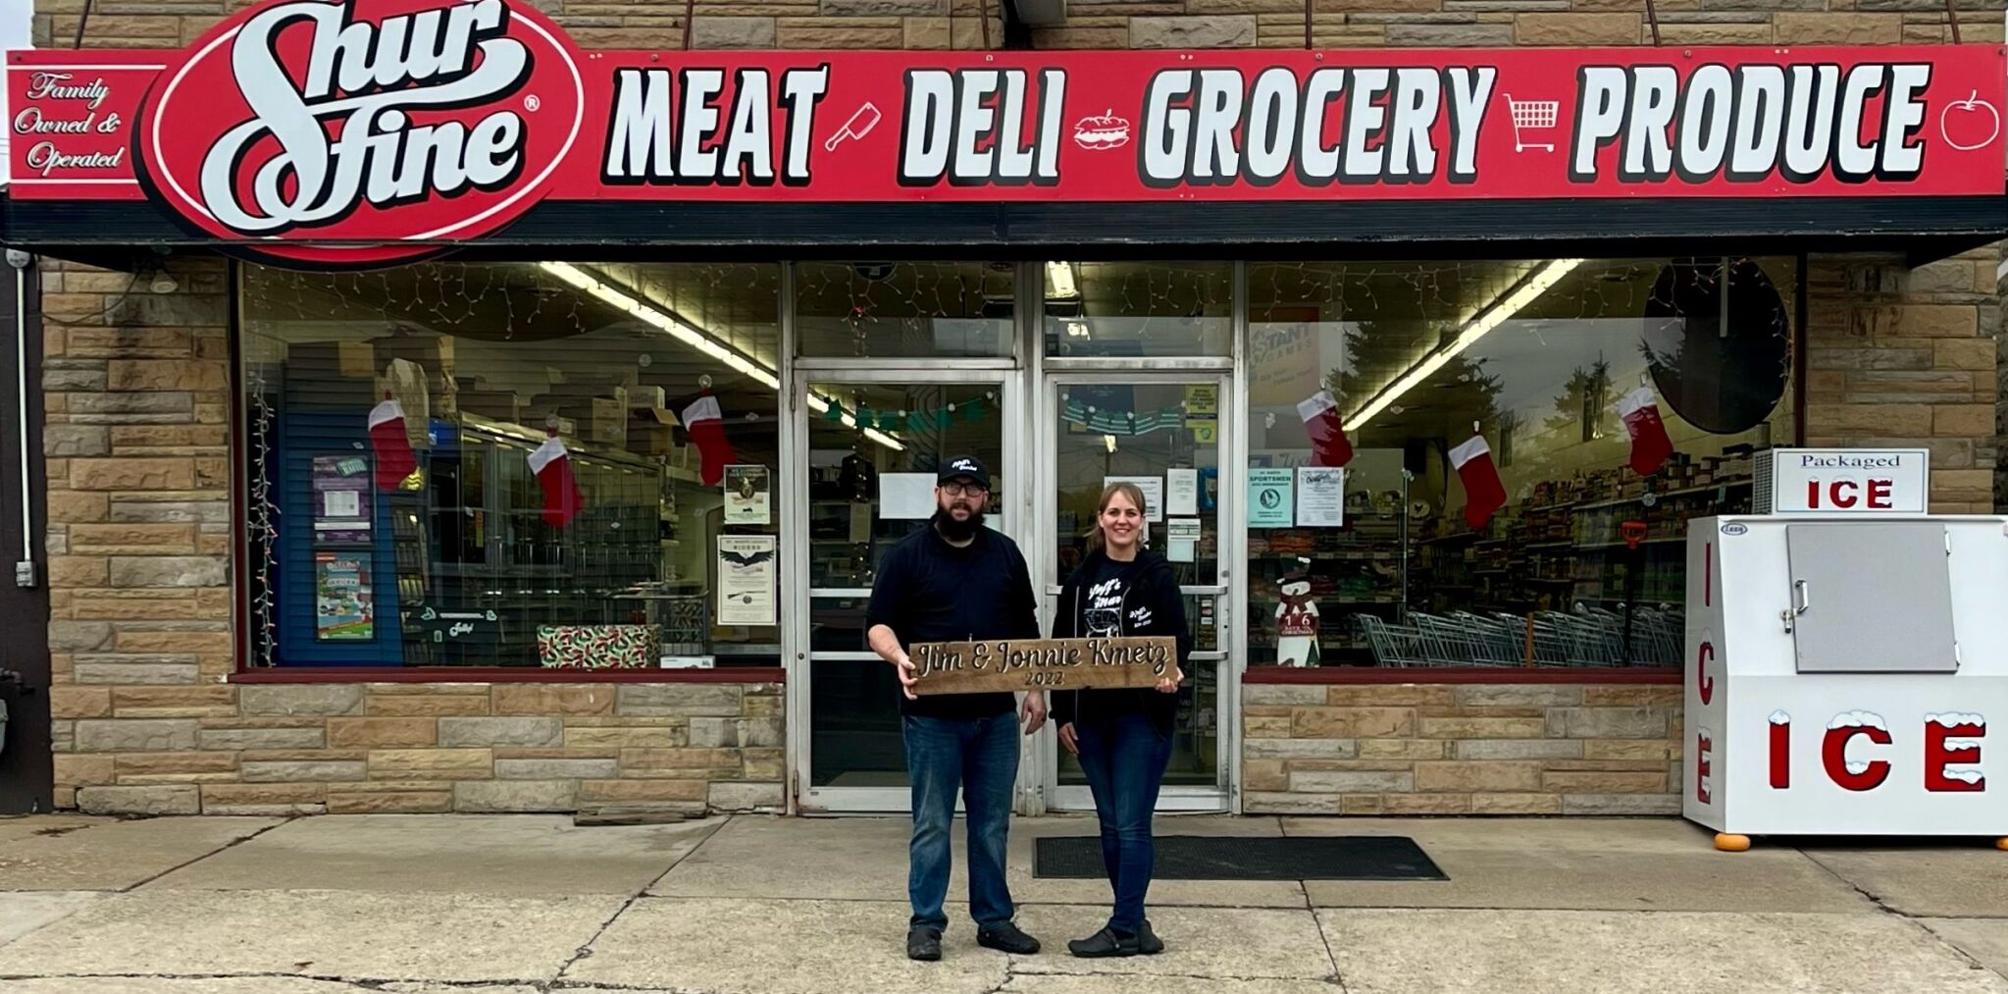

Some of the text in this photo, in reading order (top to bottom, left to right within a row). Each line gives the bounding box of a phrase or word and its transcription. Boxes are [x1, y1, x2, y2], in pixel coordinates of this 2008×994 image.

[27, 72, 109, 110] Family
[14, 107, 121, 134] Owned &
[201, 0, 527, 230] Shur
[603, 64, 1931, 185] MEAT DELI GROCERY PRODUCE
[27, 141, 125, 176] Operated
[303, 105, 520, 212] fine
[1801, 455, 1900, 470] Packaged
[1808, 476, 1893, 509] ICE
[918, 638, 1170, 677] Jim & Jonnie Kmetz
[1025, 671, 1064, 686] 2022
[1768, 709, 1986, 793] ICE
